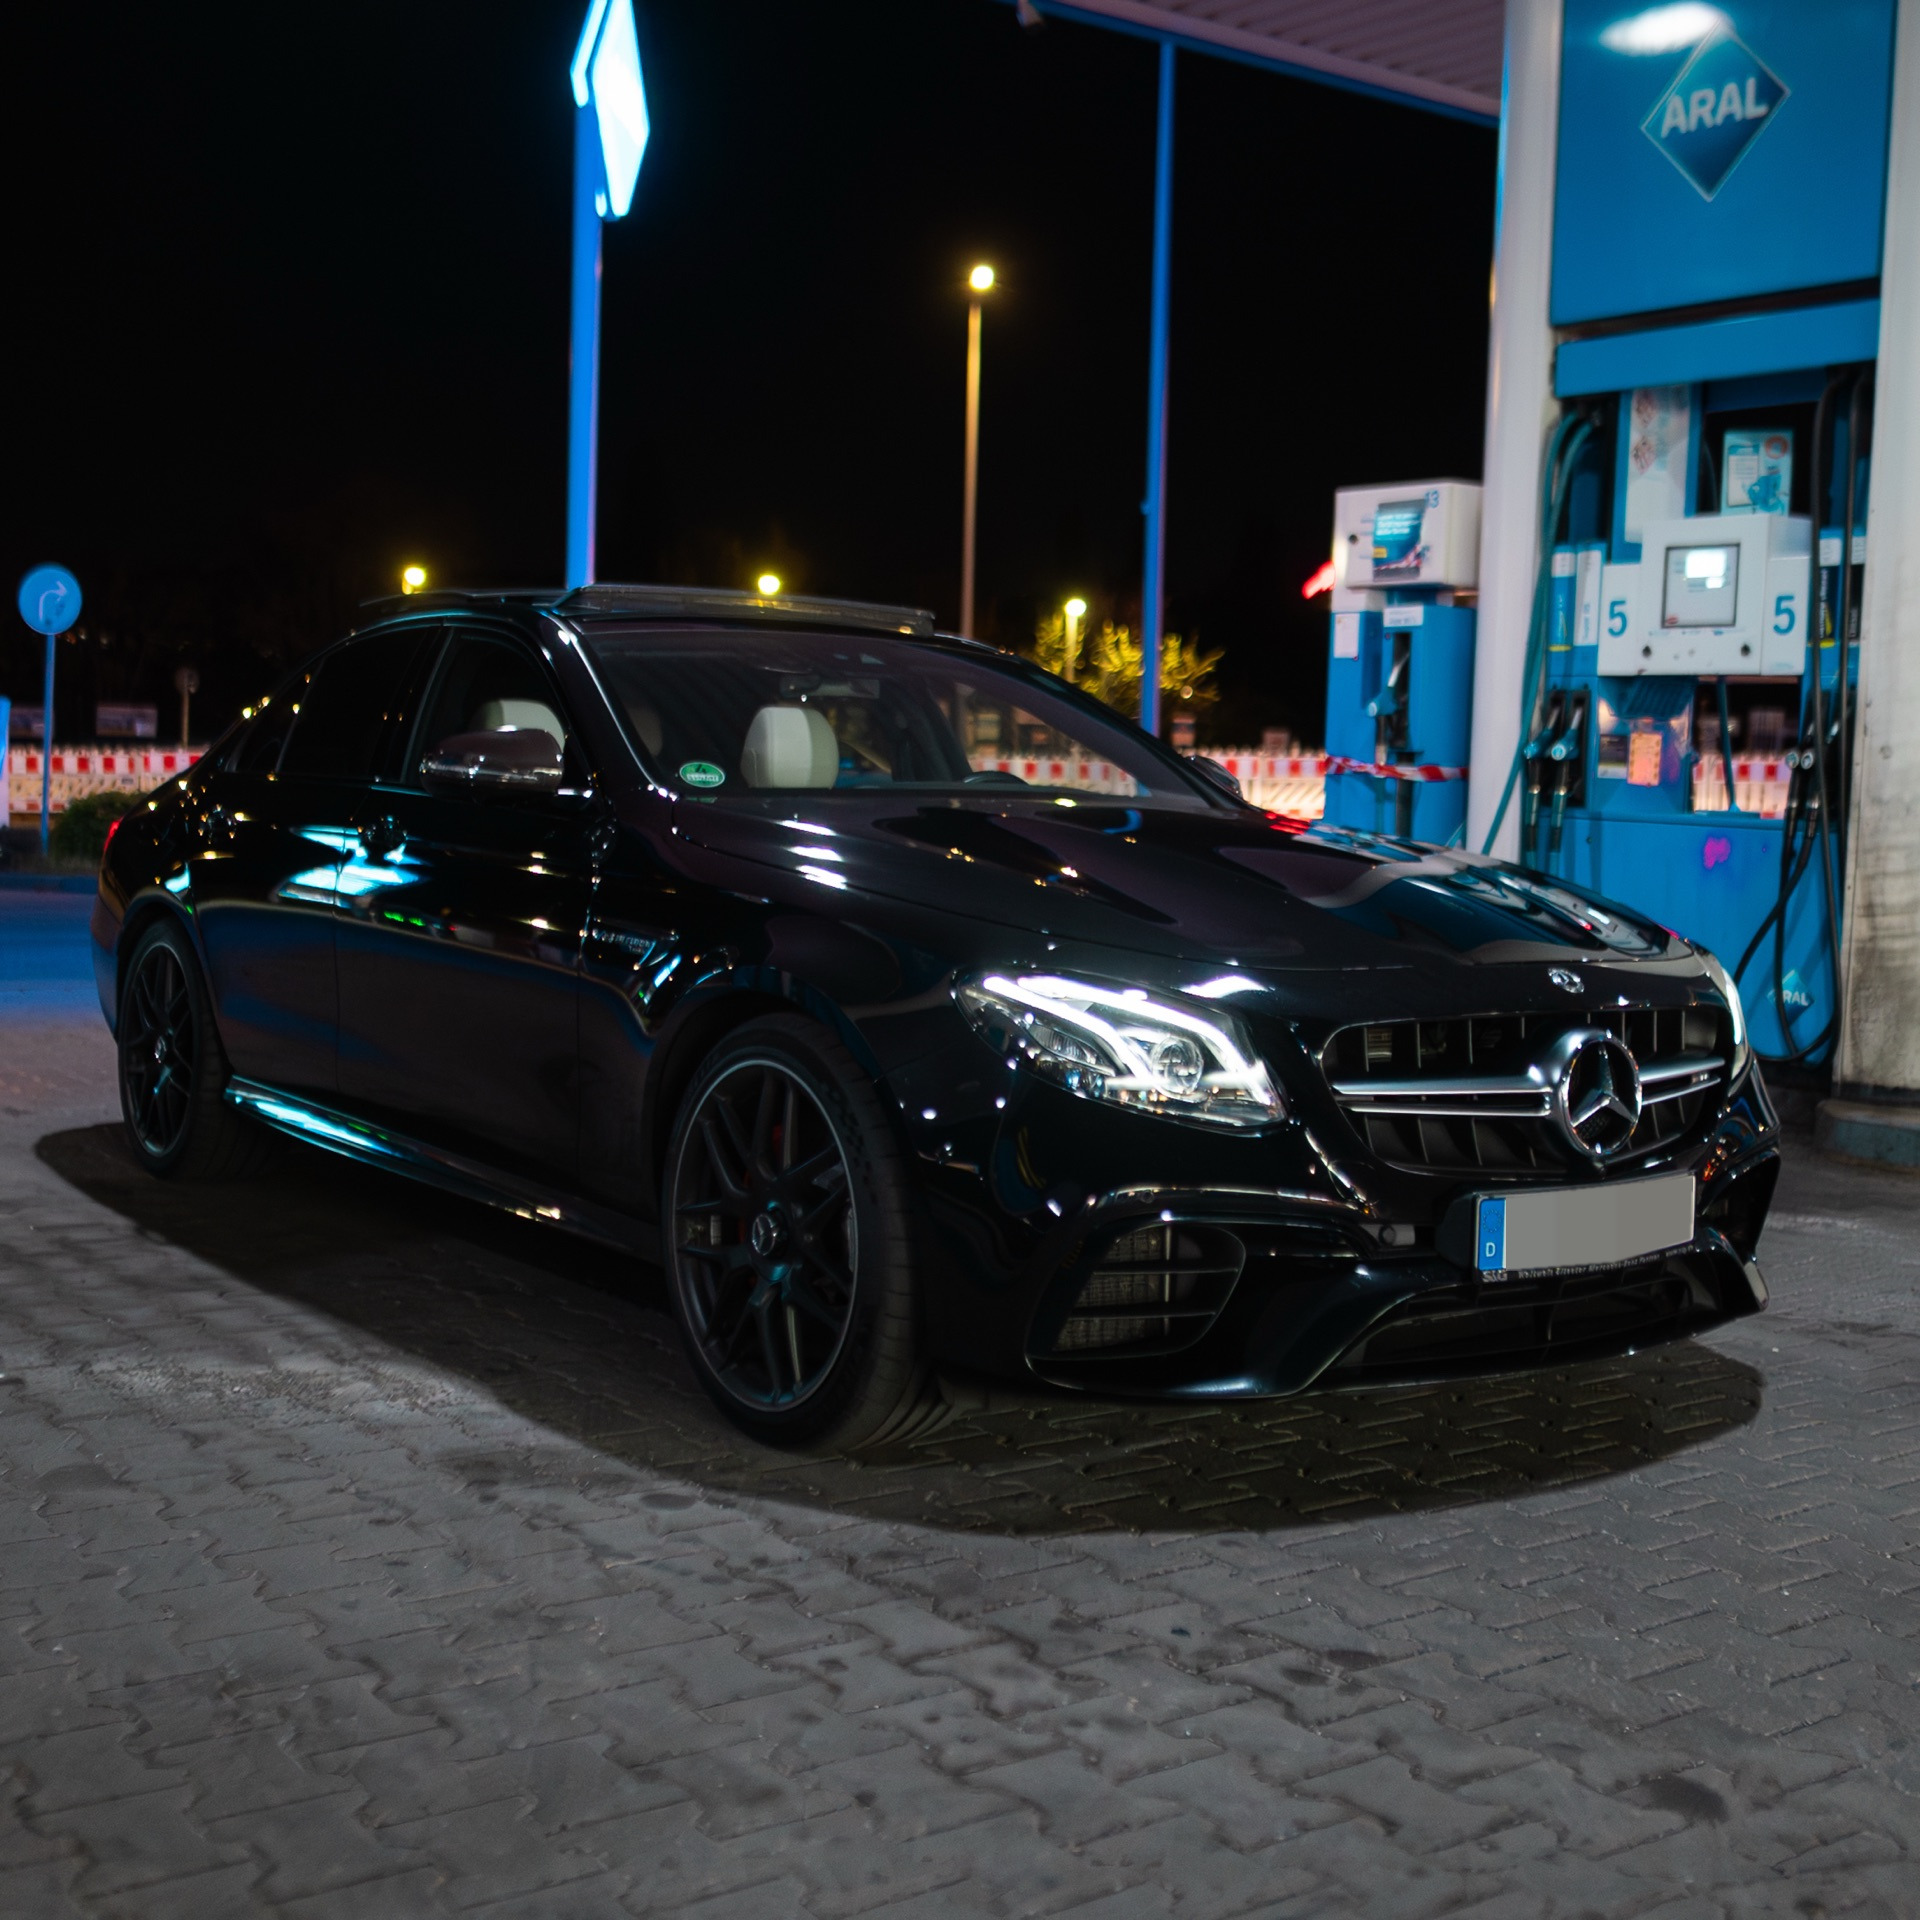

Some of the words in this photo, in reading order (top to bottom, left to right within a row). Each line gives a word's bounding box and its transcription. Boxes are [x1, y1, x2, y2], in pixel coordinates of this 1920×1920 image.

[1661, 76, 1769, 138] ARAL
[1608, 600, 1627, 637] 5
[1773, 595, 1796, 635] 5
[1773, 990, 1809, 1006] RAL
[1486, 1242, 1496, 1257] D
